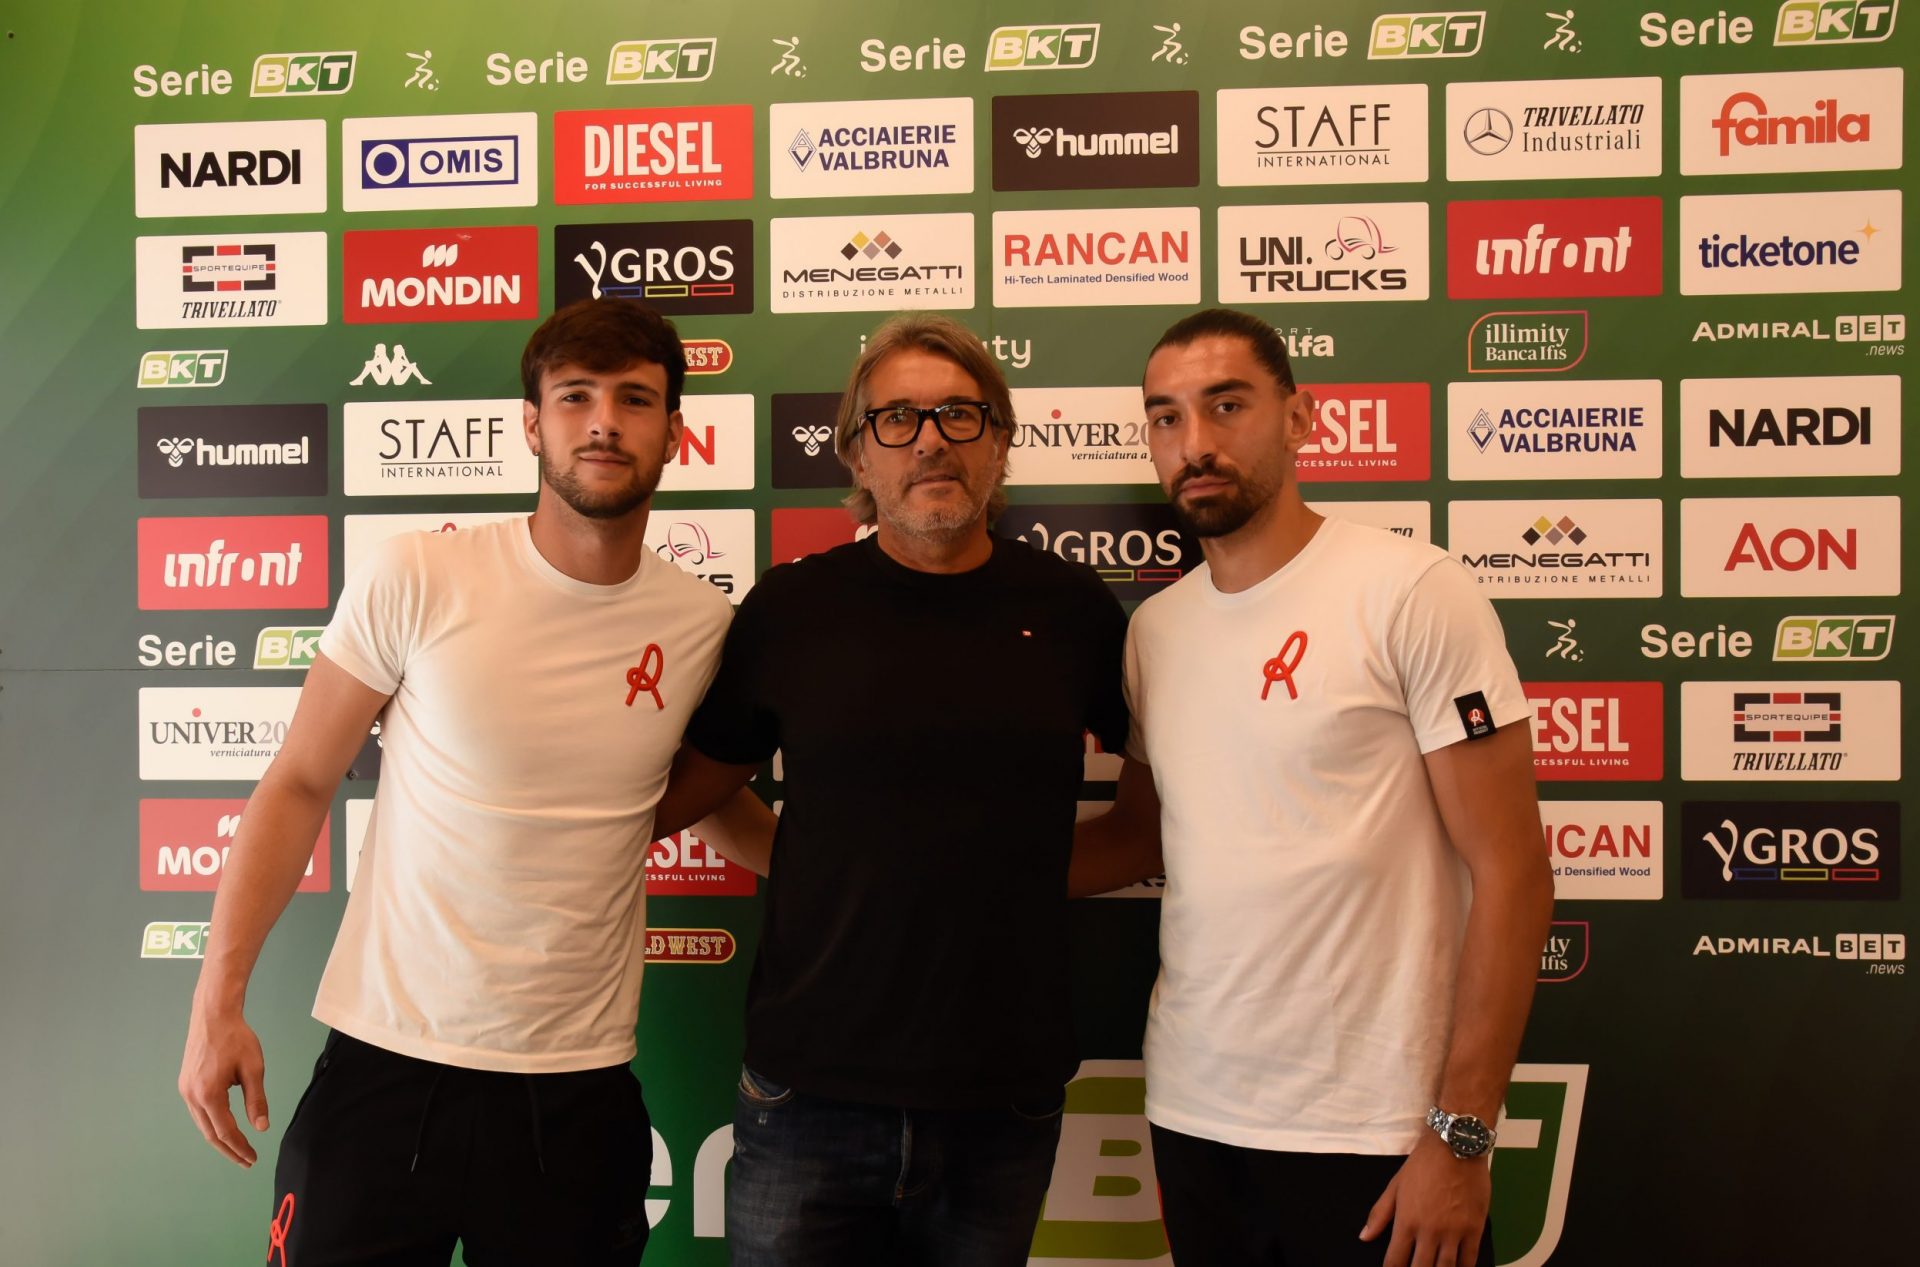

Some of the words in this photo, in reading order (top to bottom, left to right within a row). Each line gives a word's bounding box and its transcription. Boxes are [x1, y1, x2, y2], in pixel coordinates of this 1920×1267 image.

[1639, 11, 1753, 47] Serie
[1782, 5, 1891, 34] BKT
[1239, 25, 1348, 60] Serie
[1372, 22, 1480, 48] BKT
[860, 37, 966, 73] Serie
[994, 34, 1092, 60] BKT
[486, 51, 588, 85] Serie
[613, 47, 709, 74] BKT
[133, 63, 232, 97] Serie
[257, 61, 350, 87] BKT
[1255, 103, 1391, 148] STAFF
[1522, 104, 1645, 127] TRIVELLATO
[1711, 92, 1870, 157] famila
[818, 125, 956, 148] ACCIAIERIE
[1056, 124, 1179, 157] hummel
[1522, 129, 1642, 153] Industriali
[584, 121, 722, 177] DIESEL
[819, 149, 950, 171] VALBRUNA
[160, 148, 301, 189] NARDI
[419, 148, 503, 175] OMIS
[1257, 154, 1390, 168] INTERNATIONAL
[610, 181, 681, 189] SUCCESSFUL
[685, 179, 723, 187] LIVING
[1004, 231, 1189, 267] RANCAN
[1240, 236, 1312, 266] UNI.
[1475, 223, 1632, 275] infront
[1699, 234, 1860, 268] ticketone
[193, 264, 265, 273] SPORTEQUIPE
[783, 265, 963, 284] MENEGATTI
[1004, 274, 1044, 285] Hi-Tech
[1047, 273, 1102, 284] Laminated
[1105, 272, 1155, 283] Densified
[1158, 271, 1189, 282] Wood
[361, 274, 520, 308] MONDIN
[1240, 268, 1407, 293] TRUCKS
[782, 288, 896, 299] DISTRIBUZIONE
[904, 287, 964, 296] METALLI
[1274, 327, 1313, 335] ORT
[1485, 323, 1570, 347] illimity
[1840, 319, 1901, 338] BET
[684, 346, 723, 367] EST
[1485, 346, 1537, 361] Banca
[1540, 345, 1567, 360] Ifis
[1865, 344, 1905, 356] .news
[143, 358, 222, 380] BKT
[1298, 399, 1397, 454] SEL
[1499, 407, 1644, 429] ACCIAIERIE
[1710, 407, 1871, 448] NARDI
[379, 417, 503, 459] STAFF
[1500, 432, 1637, 453] VALBRUNA
[197, 436, 308, 466] hummel
[1072, 451, 1137, 460] verniciatura
[381, 466, 503, 478] INTERNATIONAL
[1358, 459, 1397, 467] LIVING
[1724, 522, 1857, 571] AON
[164, 539, 302, 588] infront
[1462, 552, 1649, 568] MENEGATTI
[1478, 575, 1578, 583] STRIBUZIONE
[1589, 575, 1651, 583] METALLI
[138, 634, 236, 667] Serie
[261, 636, 320, 659] BK
[1640, 624, 1753, 659] Serie
[1781, 626, 1888, 651] BKT
[1527, 697, 1629, 753] ESEL
[1746, 712, 1828, 722] SPORTEQUIPE
[150, 721, 288, 744] UNIVER20
[211, 748, 270, 757] verniciatura
[1533, 758, 1586, 766] CESSFUL
[1590, 758, 1629, 766] LIVING
[1545, 824, 1650, 858] CAN
[1565, 867, 1616, 876] Densified
[1620, 867, 1650, 876] Wood
[147, 931, 208, 950] BK
[668, 936, 726, 955] WEST
[1840, 939, 1901, 955] BET
[1866, 962, 1905, 975] .news
